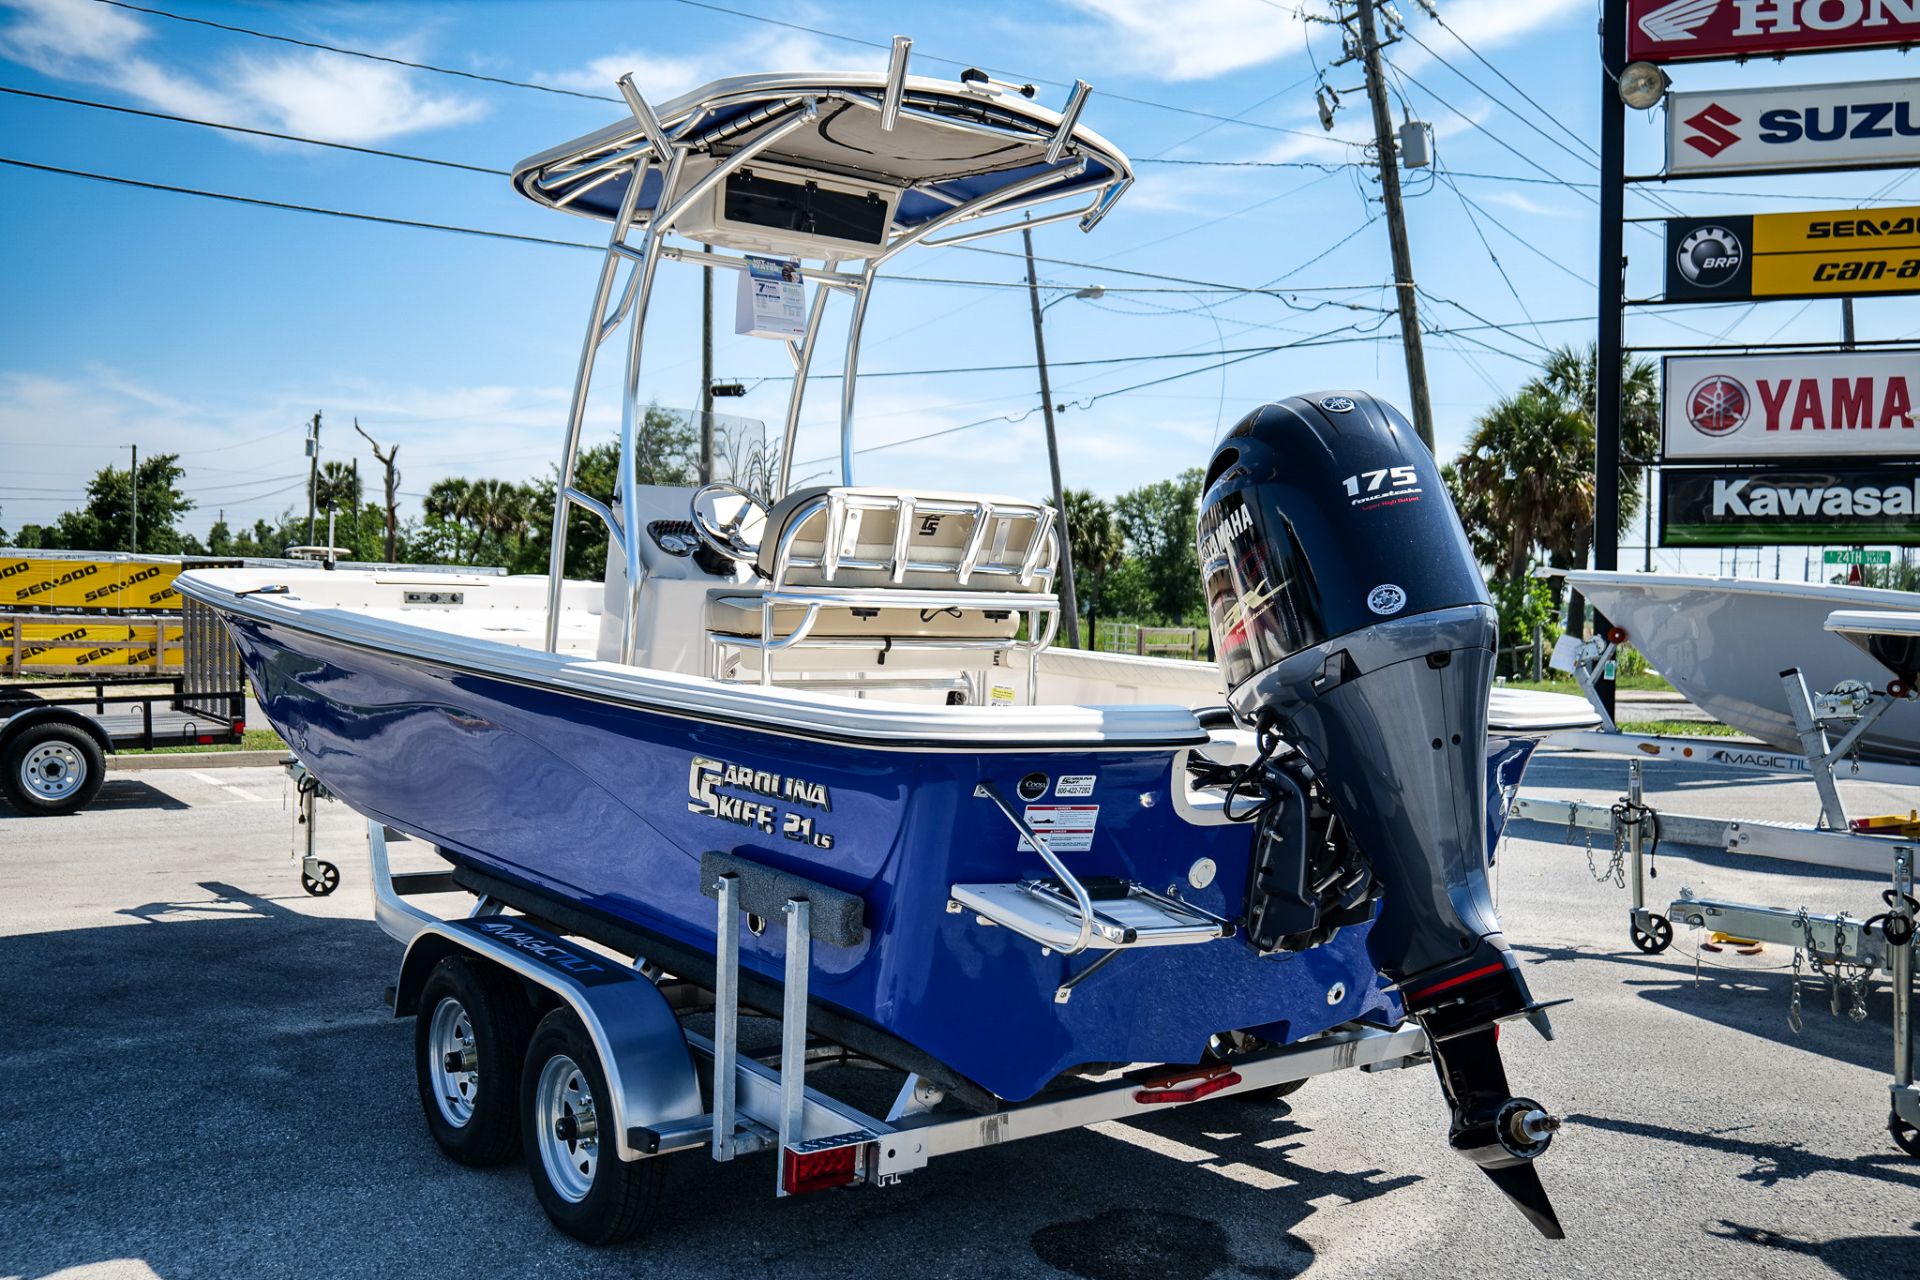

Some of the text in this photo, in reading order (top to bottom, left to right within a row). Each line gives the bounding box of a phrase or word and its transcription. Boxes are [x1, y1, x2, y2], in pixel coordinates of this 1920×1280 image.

[1703, 257, 1738, 268] BRP
[758, 283, 766, 292] 7
[1756, 376, 1914, 431] YAMA
[1342, 464, 1418, 497] 175
[1712, 477, 1920, 516] Kawasa
[1208, 503, 1254, 560] YAMAHA
[1837, 551, 1862, 563] 24TH
[1724, 752, 1812, 771] MAGICTIL
[688, 756, 832, 812] CAROLINA
[783, 812, 814, 844] 21
[813, 833, 834, 850] LS
